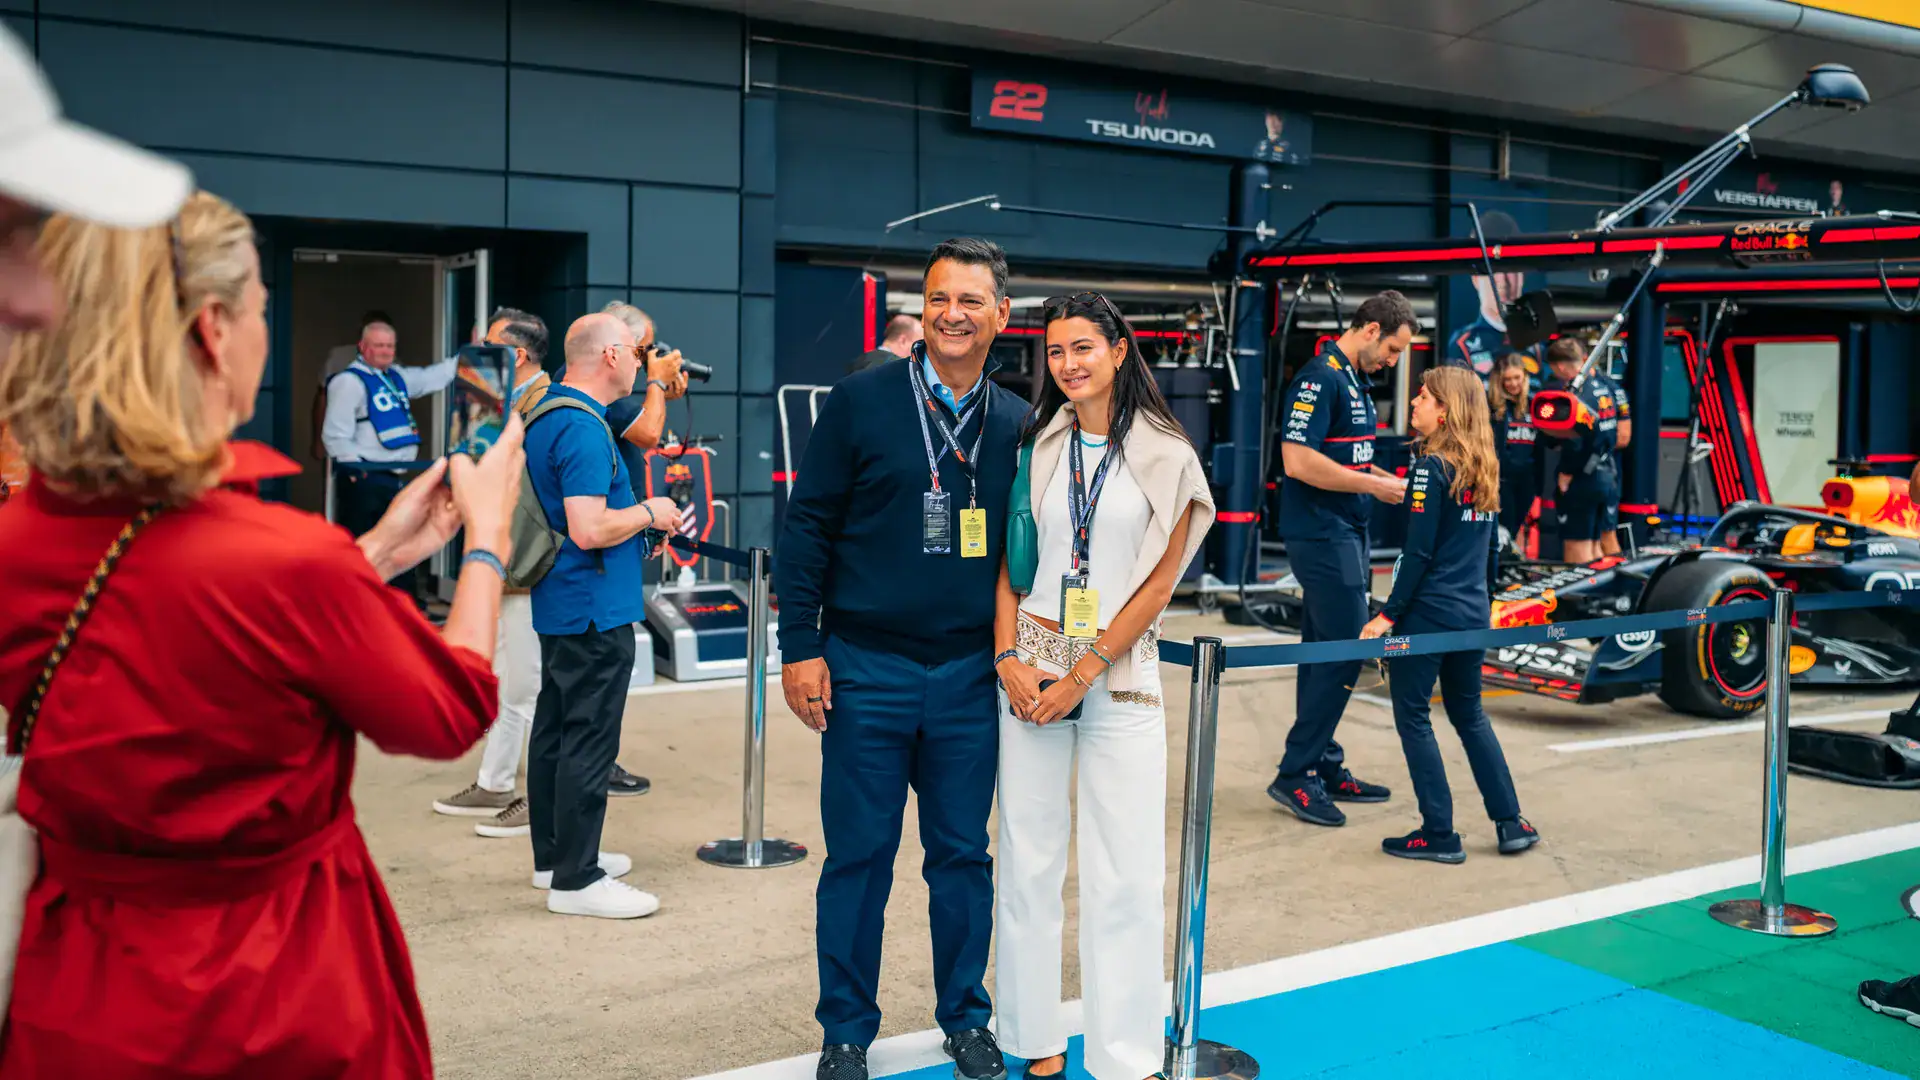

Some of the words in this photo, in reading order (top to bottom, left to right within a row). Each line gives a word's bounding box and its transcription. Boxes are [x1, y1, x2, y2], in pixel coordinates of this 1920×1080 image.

[989, 80, 1048, 122] 22
[1086, 119, 1216, 148] TSUNODA
[1714, 188, 1817, 211] VERSTAPPEN
[1733, 221, 1814, 235] ORACLE
[1731, 236, 1750, 250] Red
[1752, 235, 1773, 249] Bull
[938, 420, 959, 451] Experiences
[1384, 637, 1410, 645] ORACLE
